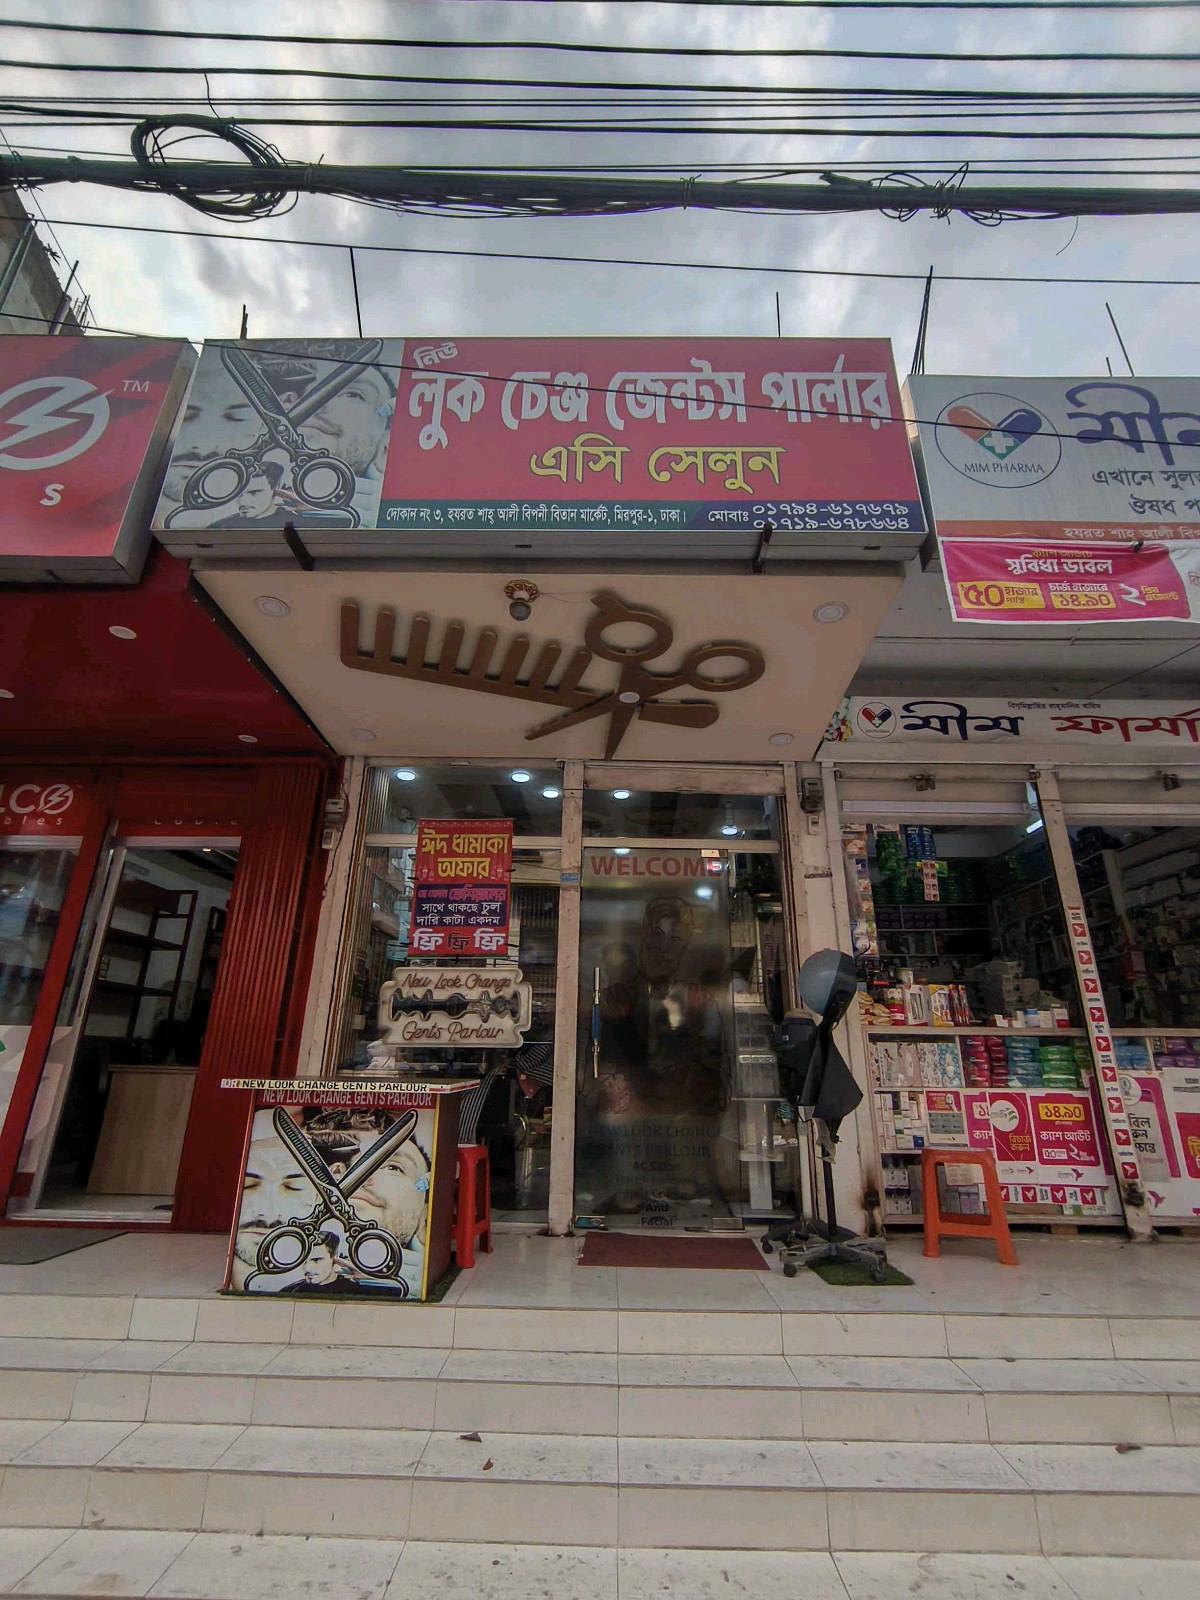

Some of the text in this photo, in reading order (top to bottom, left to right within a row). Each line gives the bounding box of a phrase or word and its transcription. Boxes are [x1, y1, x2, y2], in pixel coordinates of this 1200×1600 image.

[412, 341, 459, 368] নিউ
[122, 380, 150, 392] TM
[409, 354, 893, 450] লুক চেঞ্জ জেন্টস পার্লার
[530, 432, 787, 494] এসি সেলুন
[964, 463, 1045, 474] MIM PHARMA
[1092, 470, 1155, 487] এখানে
[386, 506, 417, 523] দোকান
[419, 507, 431, 522] নং
[447, 508, 475, 523] হযরত
[497, 504, 519, 523] আলী
[521, 504, 548, 523] বিপনী
[550, 504, 577, 522] বিতান
[752, 502, 909, 516] ০১৭৯৪-৬১৭৬৭৯
[1129, 494, 1177, 516] ঔষধ
[1005, 554, 1112, 575] সুবিধা ডাবল
[1004, 587, 1038, 597] হাজার
[1048, 581, 1108, 592] চার্জ হাজারে
[900, 700, 1025, 740] মীম
[421, 829, 509, 854] ঈদ ধামাকা
[438, 857, 491, 879] অফার
[590, 855, 722, 877] WELCOME
[421, 902, 502, 915] সাথে থাকছে চুল
[416, 913, 500, 925] দারি কাটা একদম
[413, 928, 506, 951] ফ্রি ফ্রি ফ্রি
[402, 973, 512, 993] New Look Change
[402, 1021, 504, 1042] Gents Parlour
[242, 1080, 428, 1092] NEW LOOK CHANGE GENTS PARLOUR
[262, 1090, 432, 1106] NEW LOOK CHANGE GENTS PARLOUR
[1040, 1129, 1091, 1141] ক্যাশ আউট
